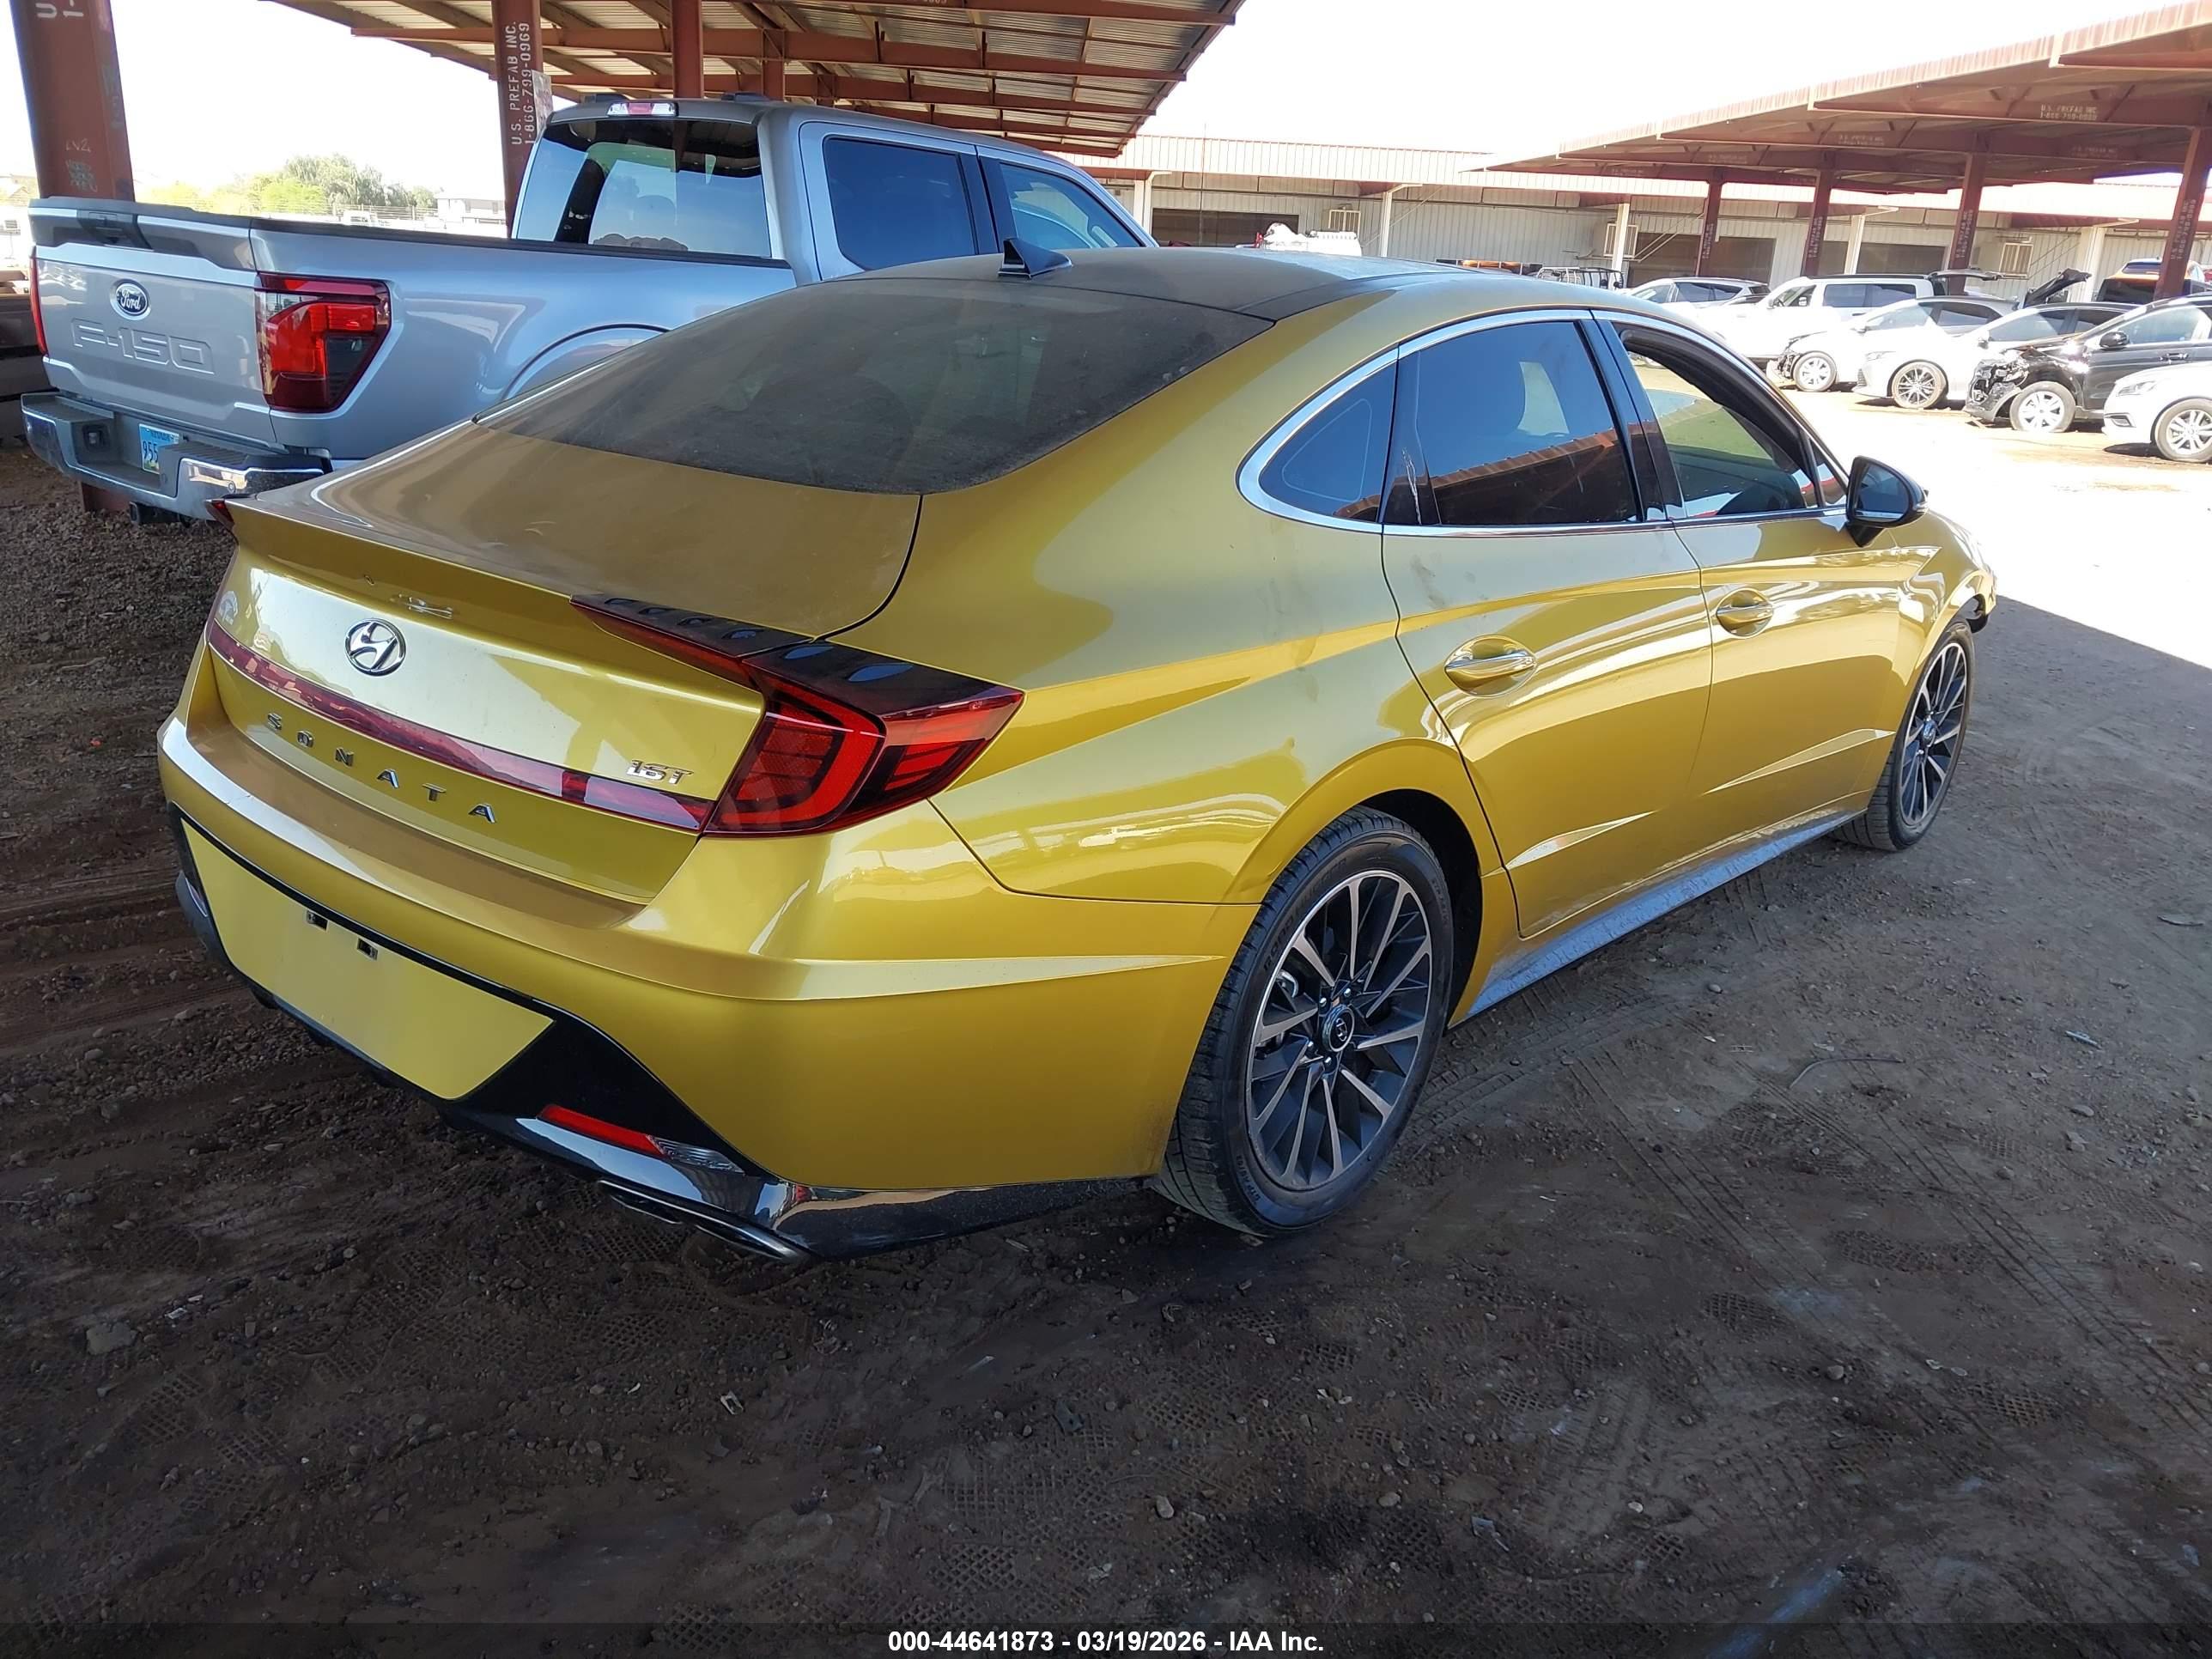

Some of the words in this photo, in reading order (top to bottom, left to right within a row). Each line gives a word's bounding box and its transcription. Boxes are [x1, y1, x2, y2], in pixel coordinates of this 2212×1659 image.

[505, 21, 517, 48] INC.
[507, 56, 520, 111] PREFAB
[519, 22, 536, 144] 1-866-799-0969
[511, 118, 522, 145] U.S.
[117, 288, 142, 311] Ford
[70, 317, 215, 374] F-150
[267, 712, 496, 824] SONATA
